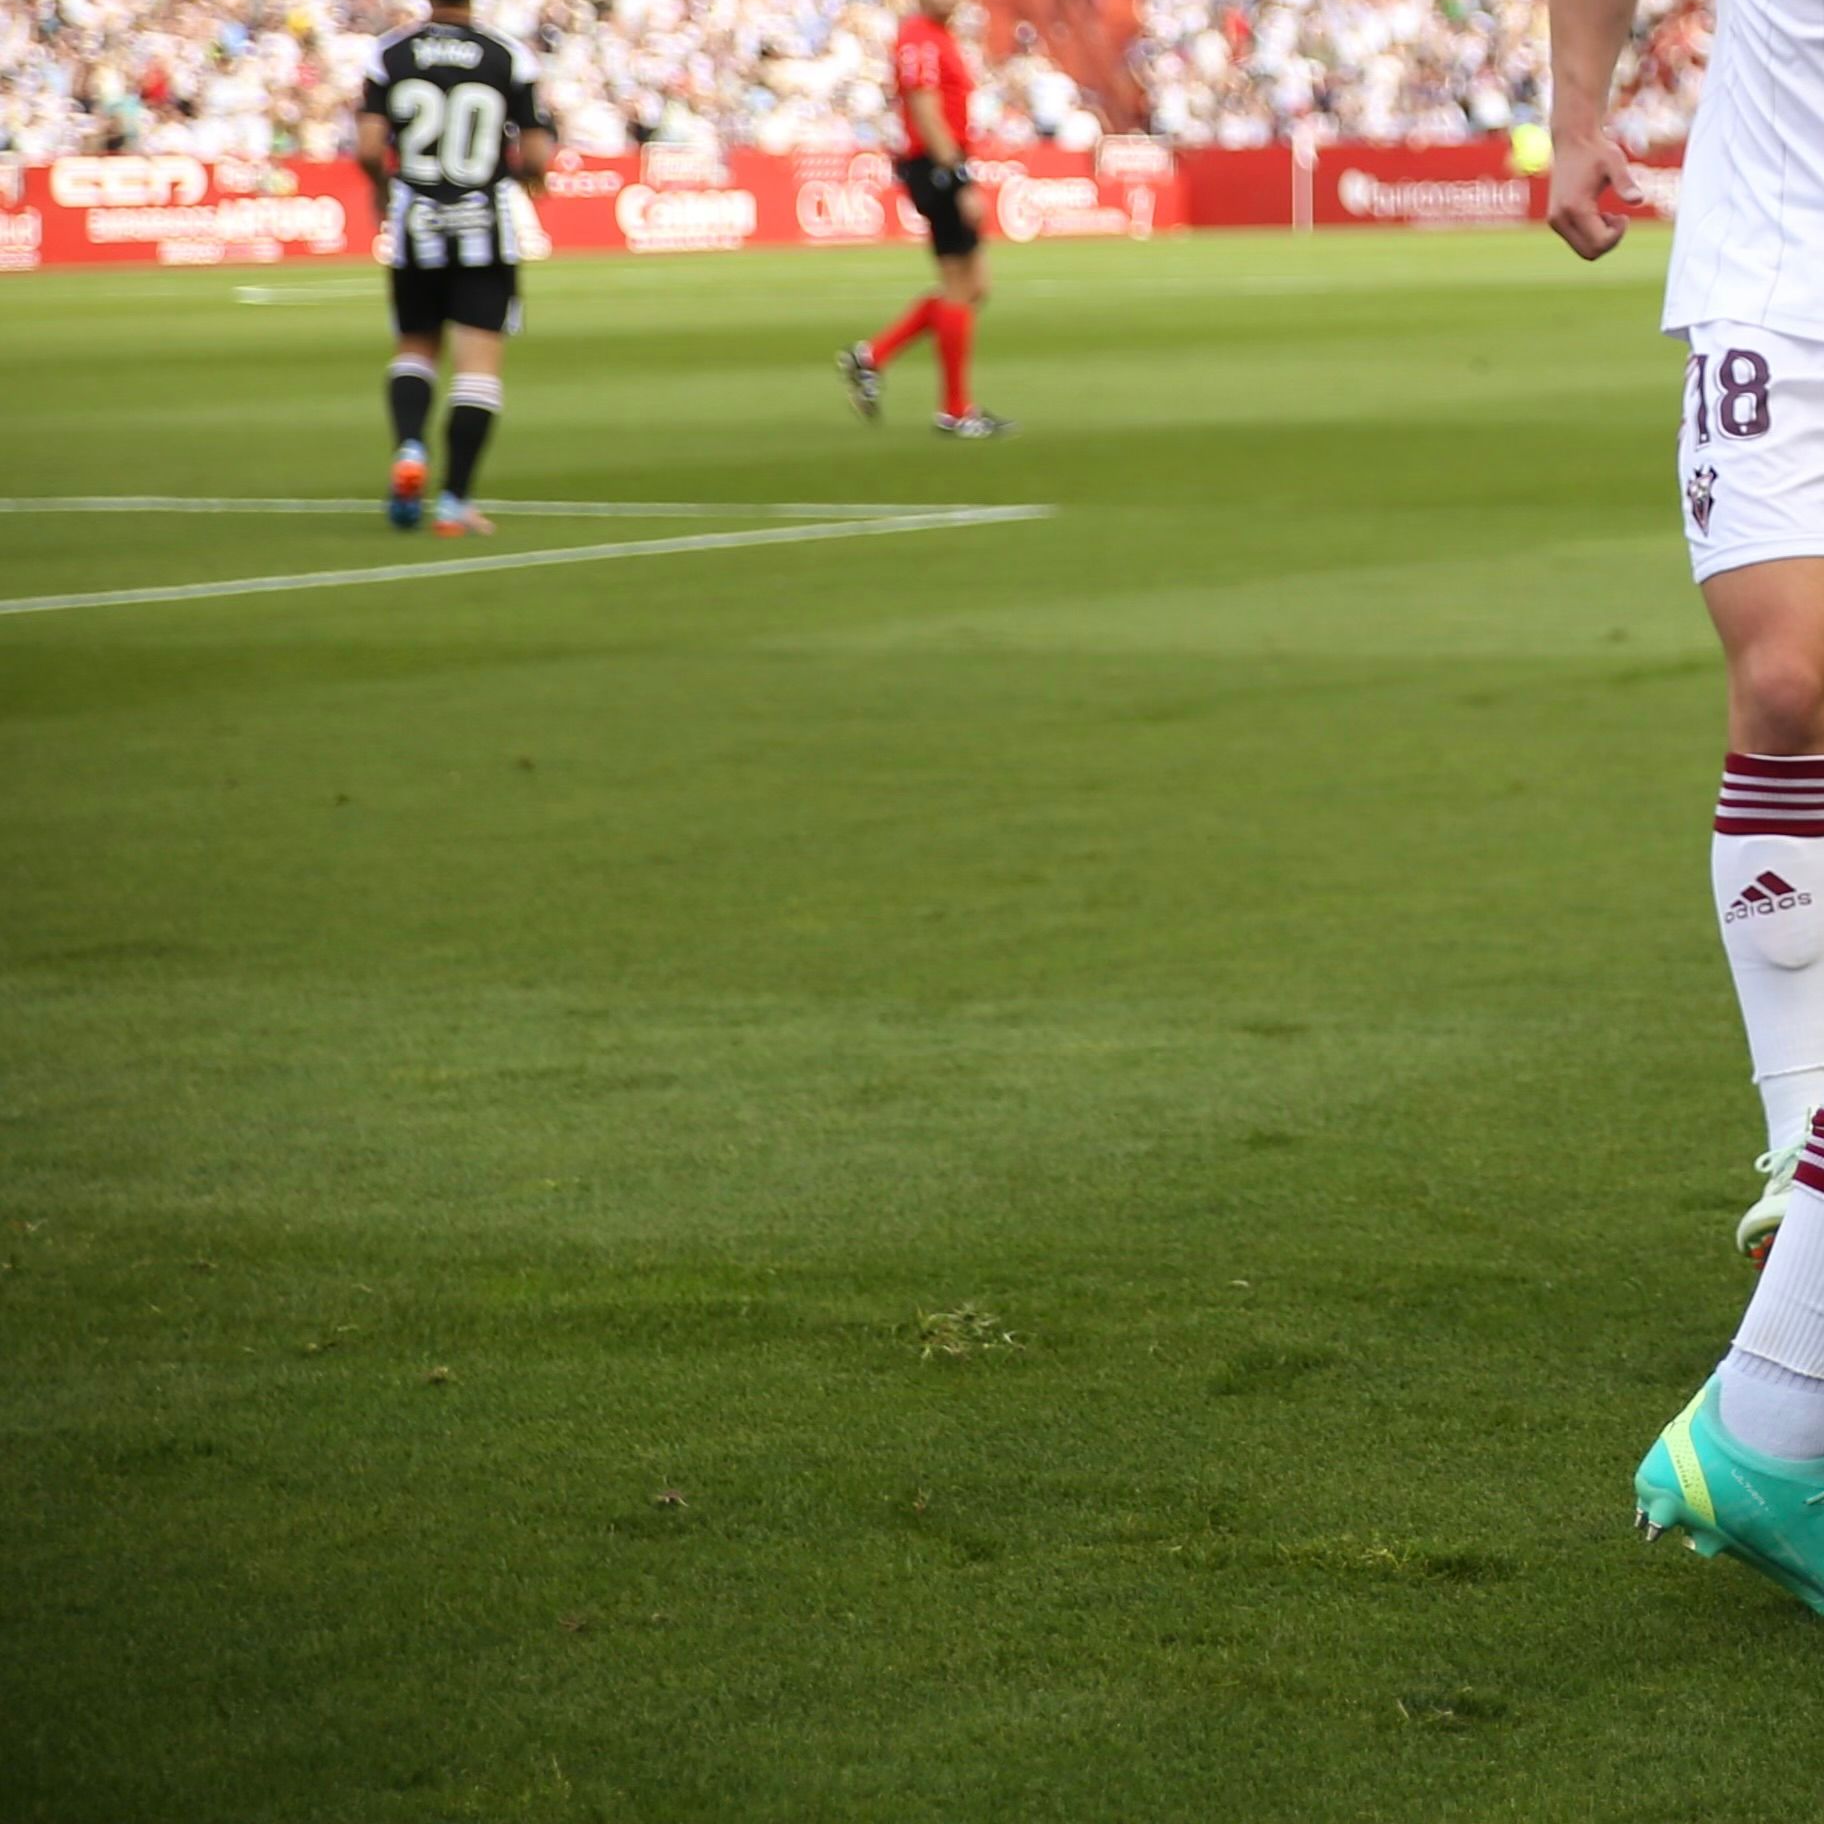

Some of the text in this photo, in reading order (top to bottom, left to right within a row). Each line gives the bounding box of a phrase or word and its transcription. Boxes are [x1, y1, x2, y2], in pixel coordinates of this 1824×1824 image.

[388, 78, 507, 188] 20
[1686, 347, 1771, 452] 18
[1724, 889, 1812, 925] adidas
